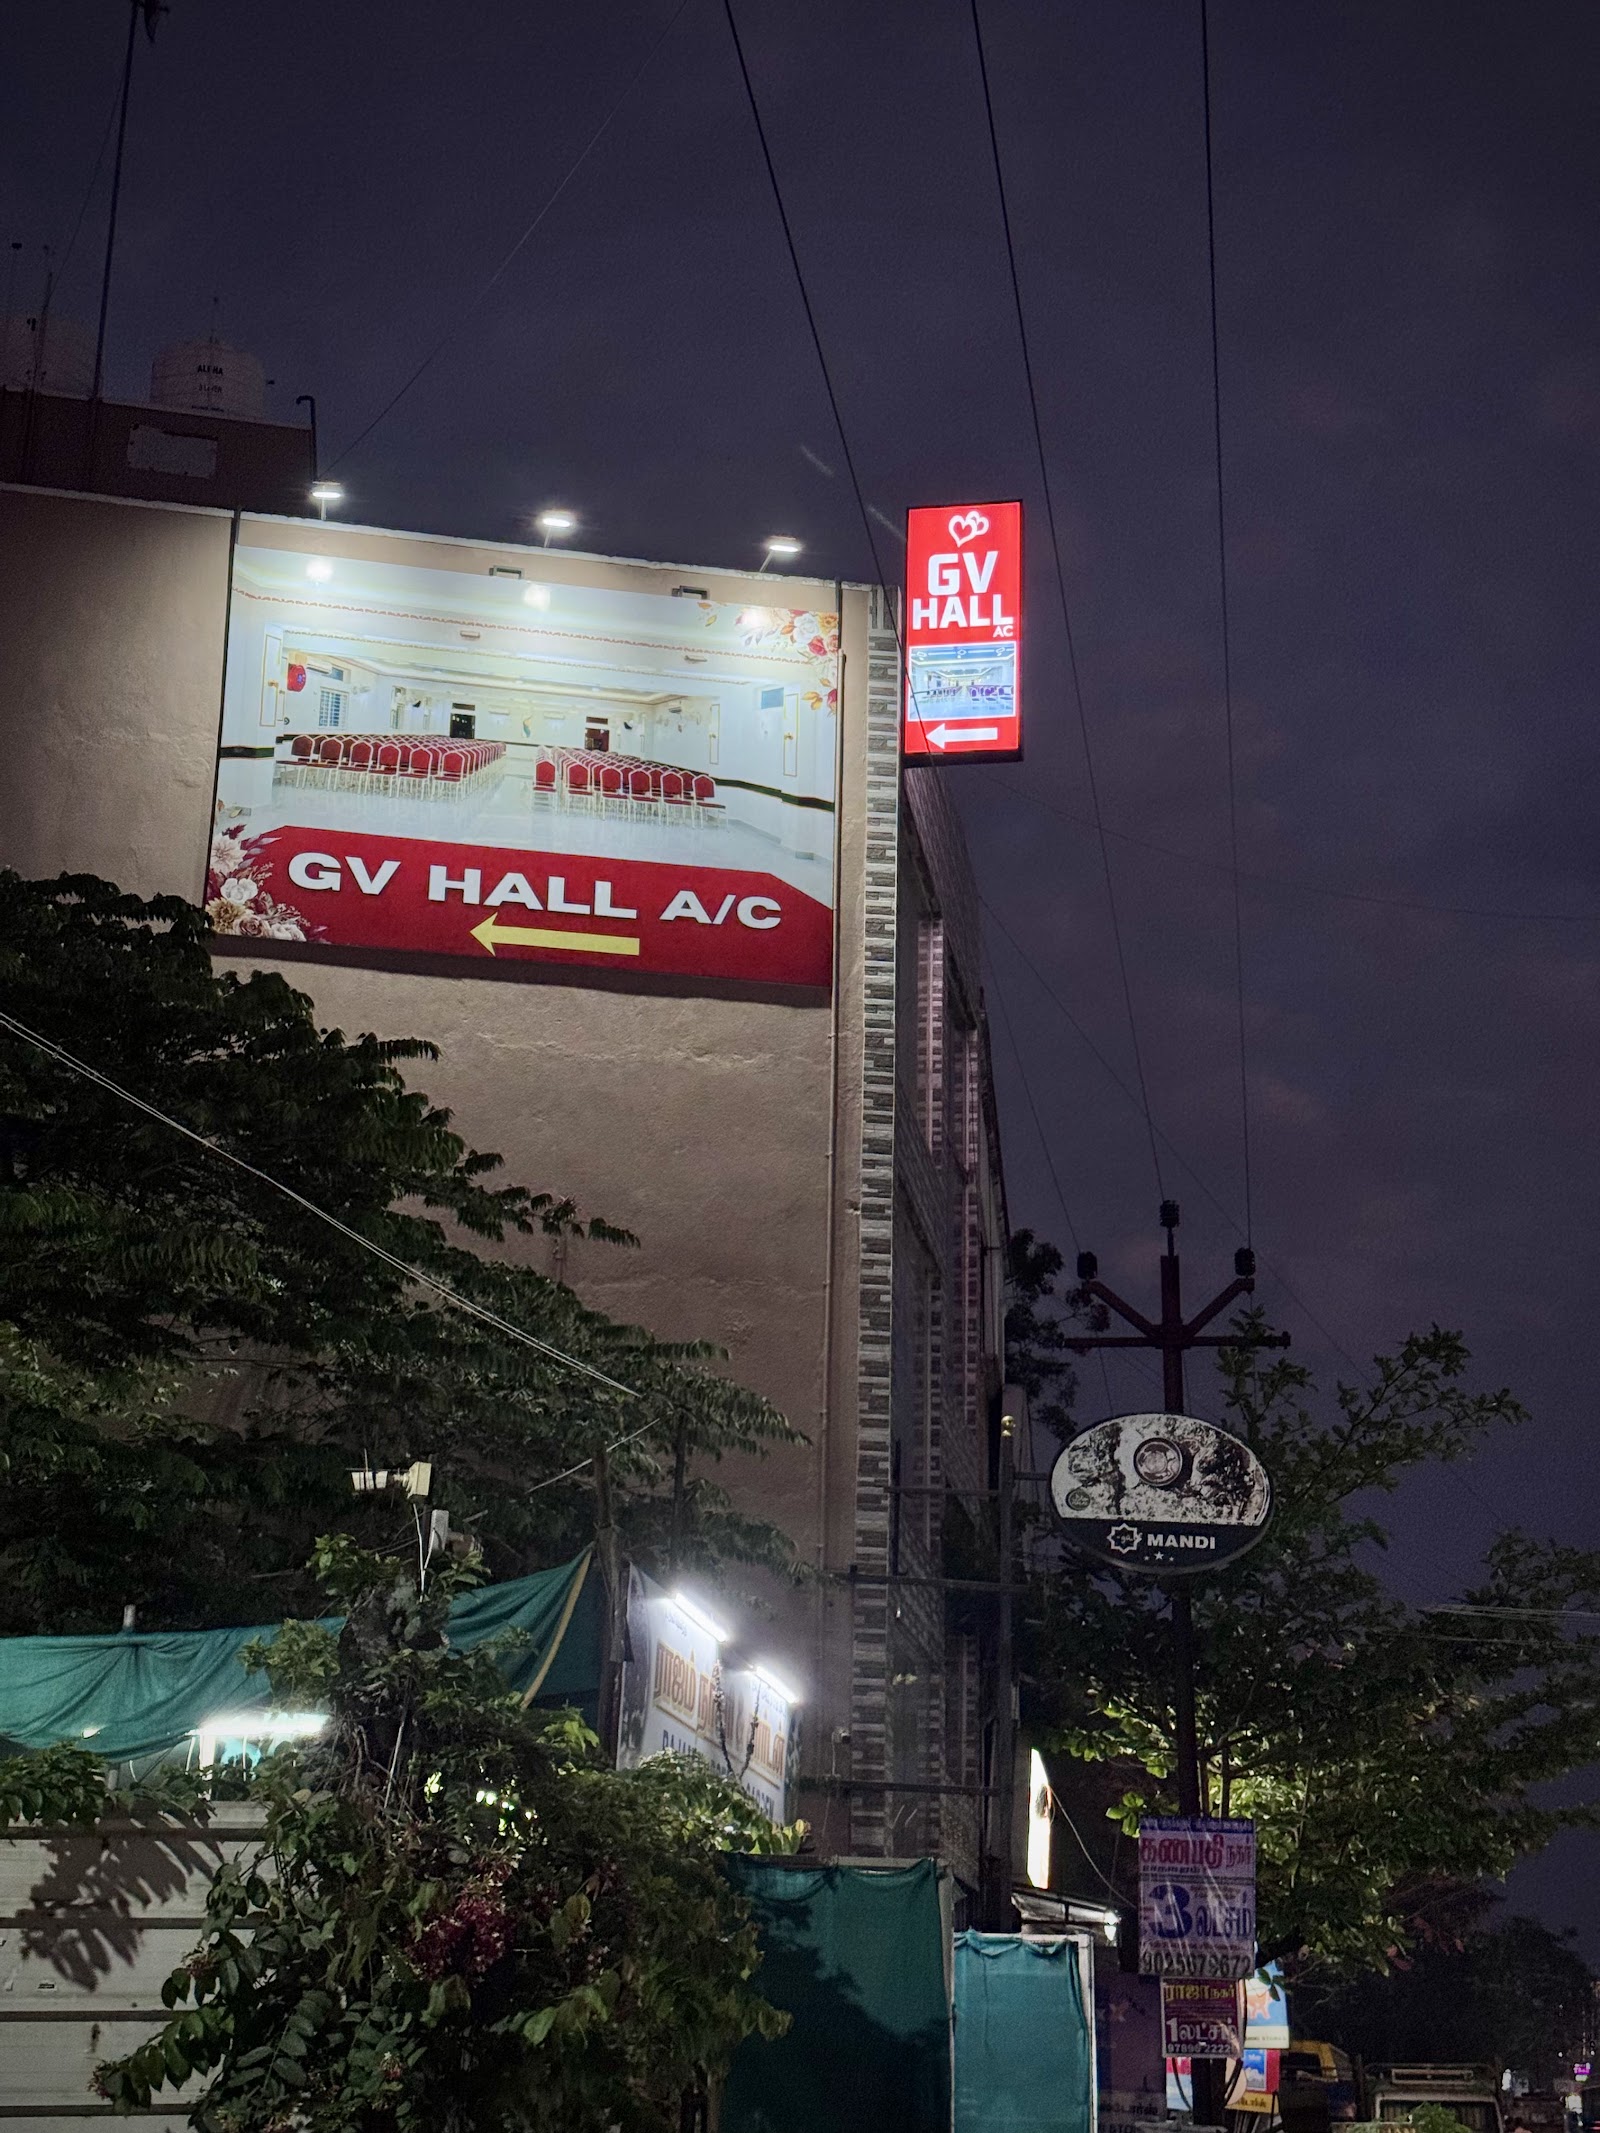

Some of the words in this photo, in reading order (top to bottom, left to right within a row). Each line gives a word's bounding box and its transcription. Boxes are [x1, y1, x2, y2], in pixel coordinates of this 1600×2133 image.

[928, 550, 999, 597] GV
[912, 594, 1014, 630] HALL
[993, 624, 1013, 638] AC
[288, 853, 401, 895] GV
[428, 865, 638, 920] HALL
[660, 889, 783, 930] A/C
[1147, 1533, 1216, 1549] MANDI
[1149, 1884, 1192, 1938] 3
[1166, 2017, 1178, 2043] 1
